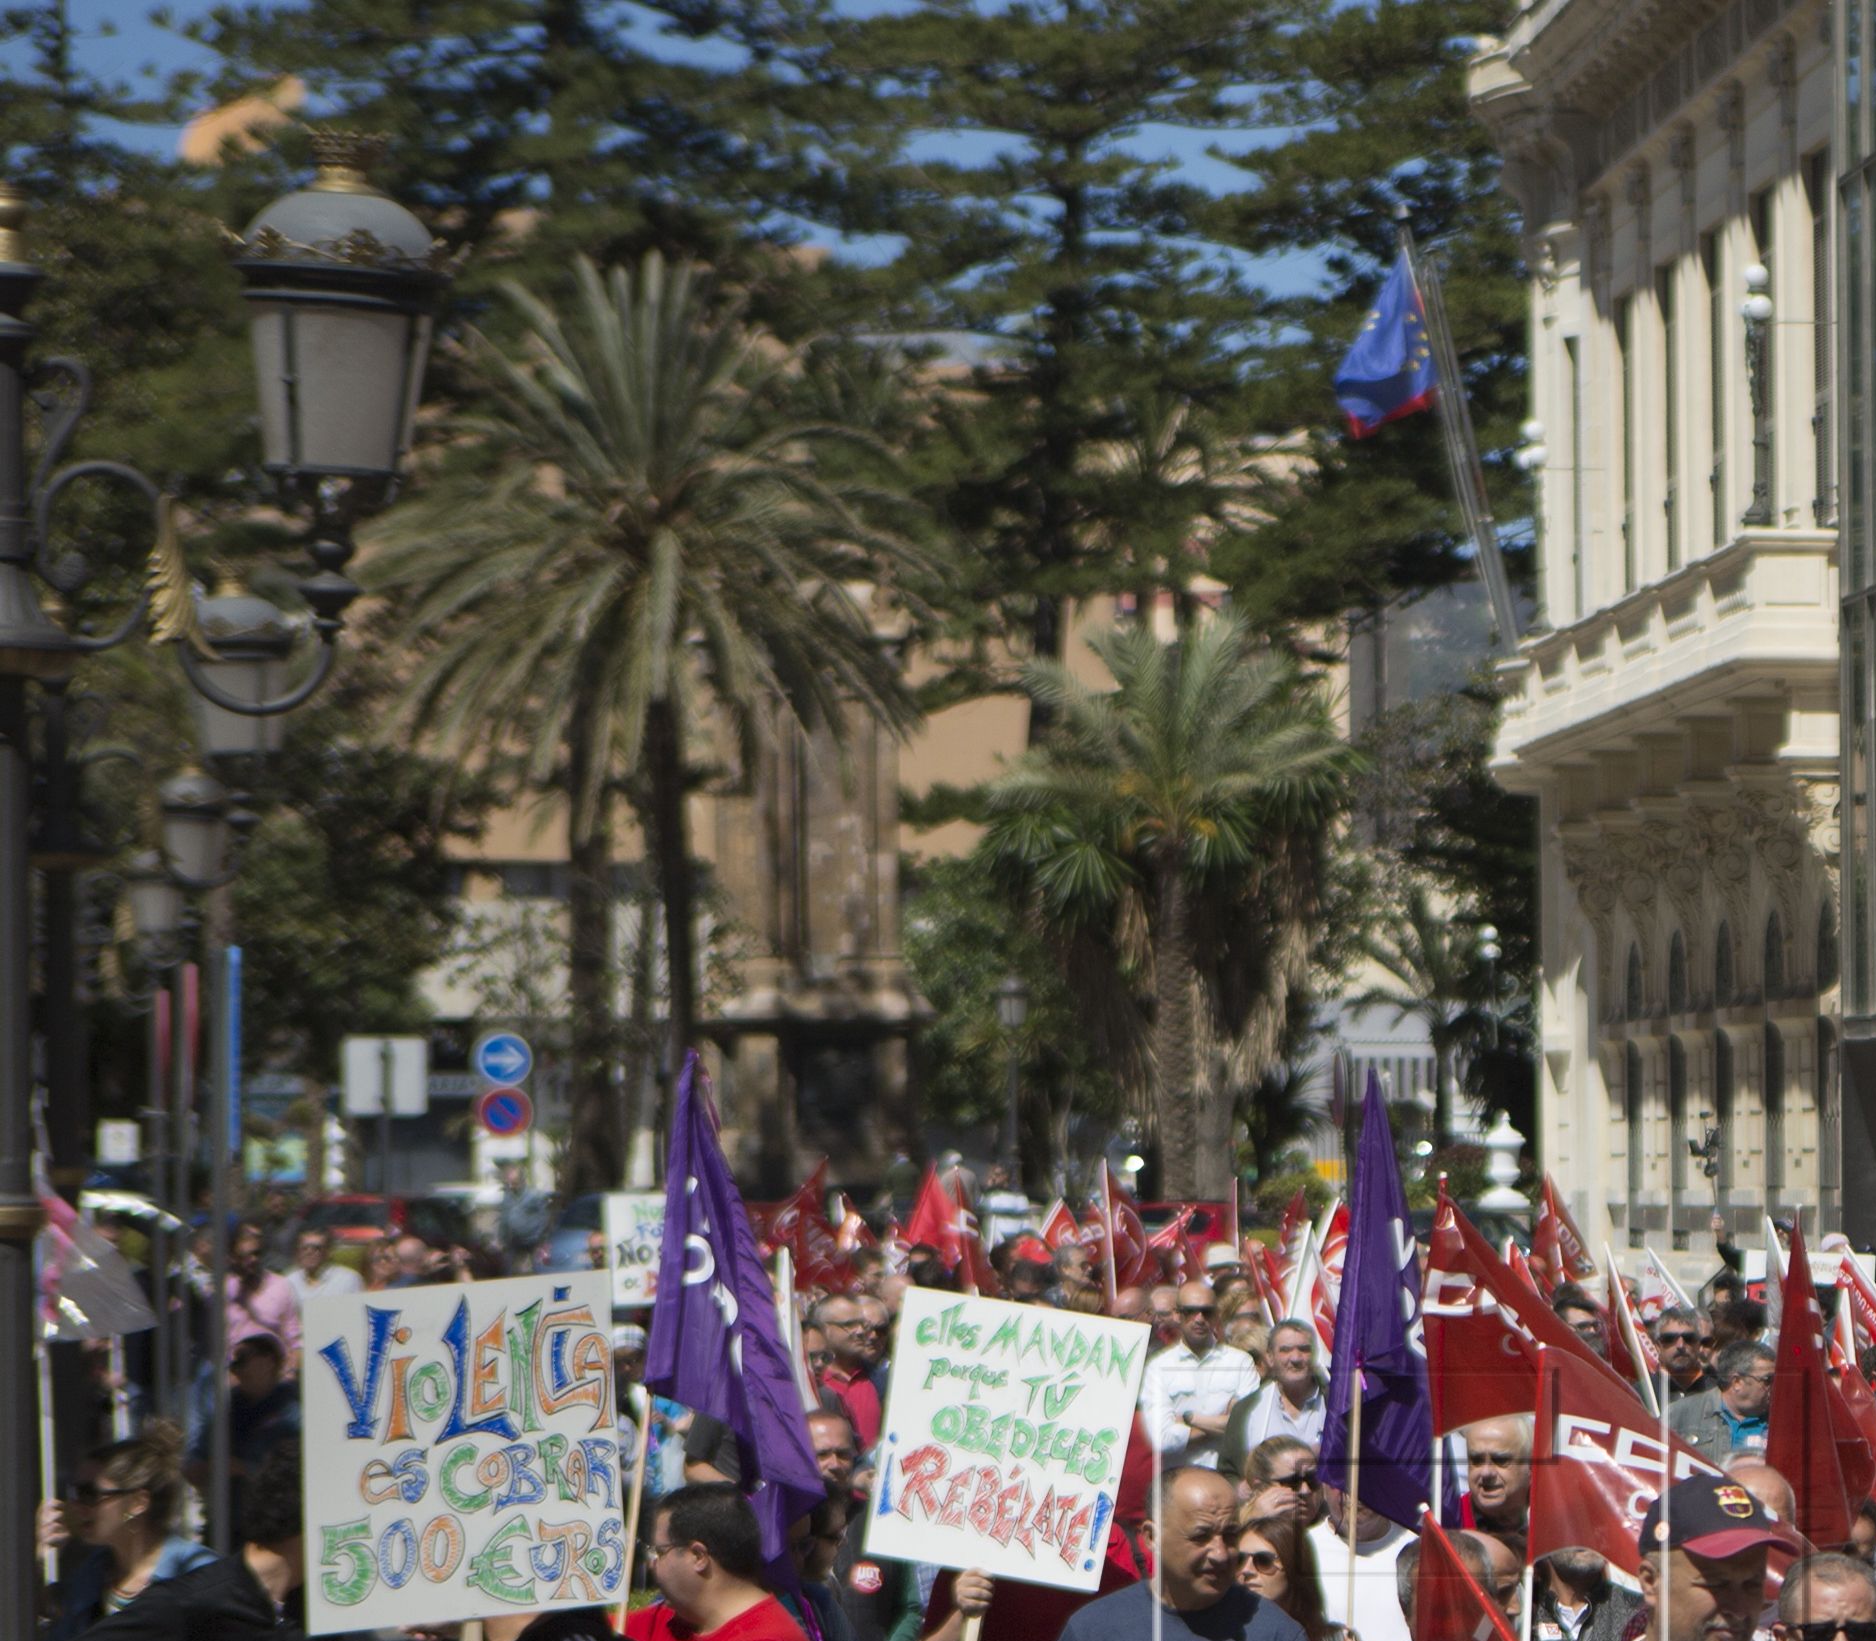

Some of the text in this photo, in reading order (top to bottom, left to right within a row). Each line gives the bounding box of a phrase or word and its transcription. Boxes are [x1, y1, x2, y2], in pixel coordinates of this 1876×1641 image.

[980, 1312, 1144, 1388] MANDAN
[922, 1357, 1087, 1420] porque TÚ
[439, 1433, 620, 1515] COBRAR
[320, 1512, 466, 1607] 500
[856, 1565, 882, 1580] UGT
